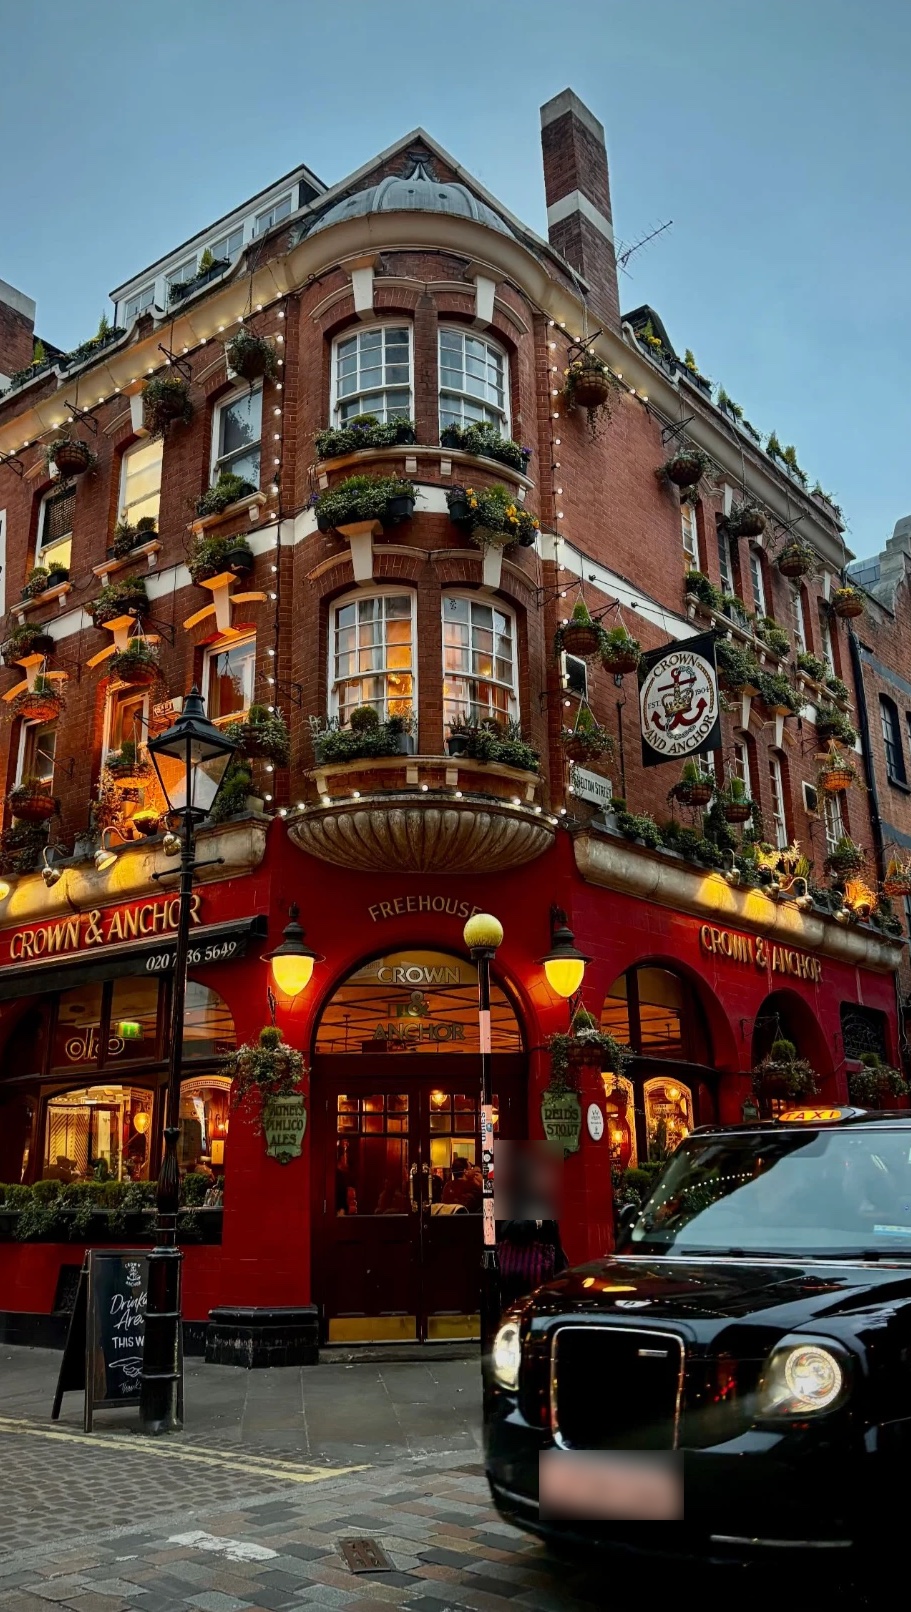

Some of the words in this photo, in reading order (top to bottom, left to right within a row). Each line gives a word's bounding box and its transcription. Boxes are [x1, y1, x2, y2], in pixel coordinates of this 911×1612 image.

[653, 654, 698, 678] CROWN
[644, 730, 667, 750] AND
[668, 714, 715, 754] ANCHOR
[368, 895, 482, 923] FREEHOUSE
[10, 920, 80, 960] CROWN
[85, 909, 104, 945] &
[107, 894, 201, 941] ANCHOR
[146, 954, 170, 971] 020
[171, 948, 202, 967] 736
[204, 941, 237, 961] 5649
[701, 924, 753, 963] CROWN
[755, 936, 768, 968] &
[772, 946, 824, 983] ANCHOR
[377, 966, 460, 983] CROWN
[407, 990, 431, 1017] &
[372, 1023, 466, 1041] ANCHOR
[785, 1111, 835, 1119] TAXI
[272, 1134, 296, 1145] ALES
[546, 1124, 579, 1136] STOUT
[112, 1336, 134, 1349] THIS
